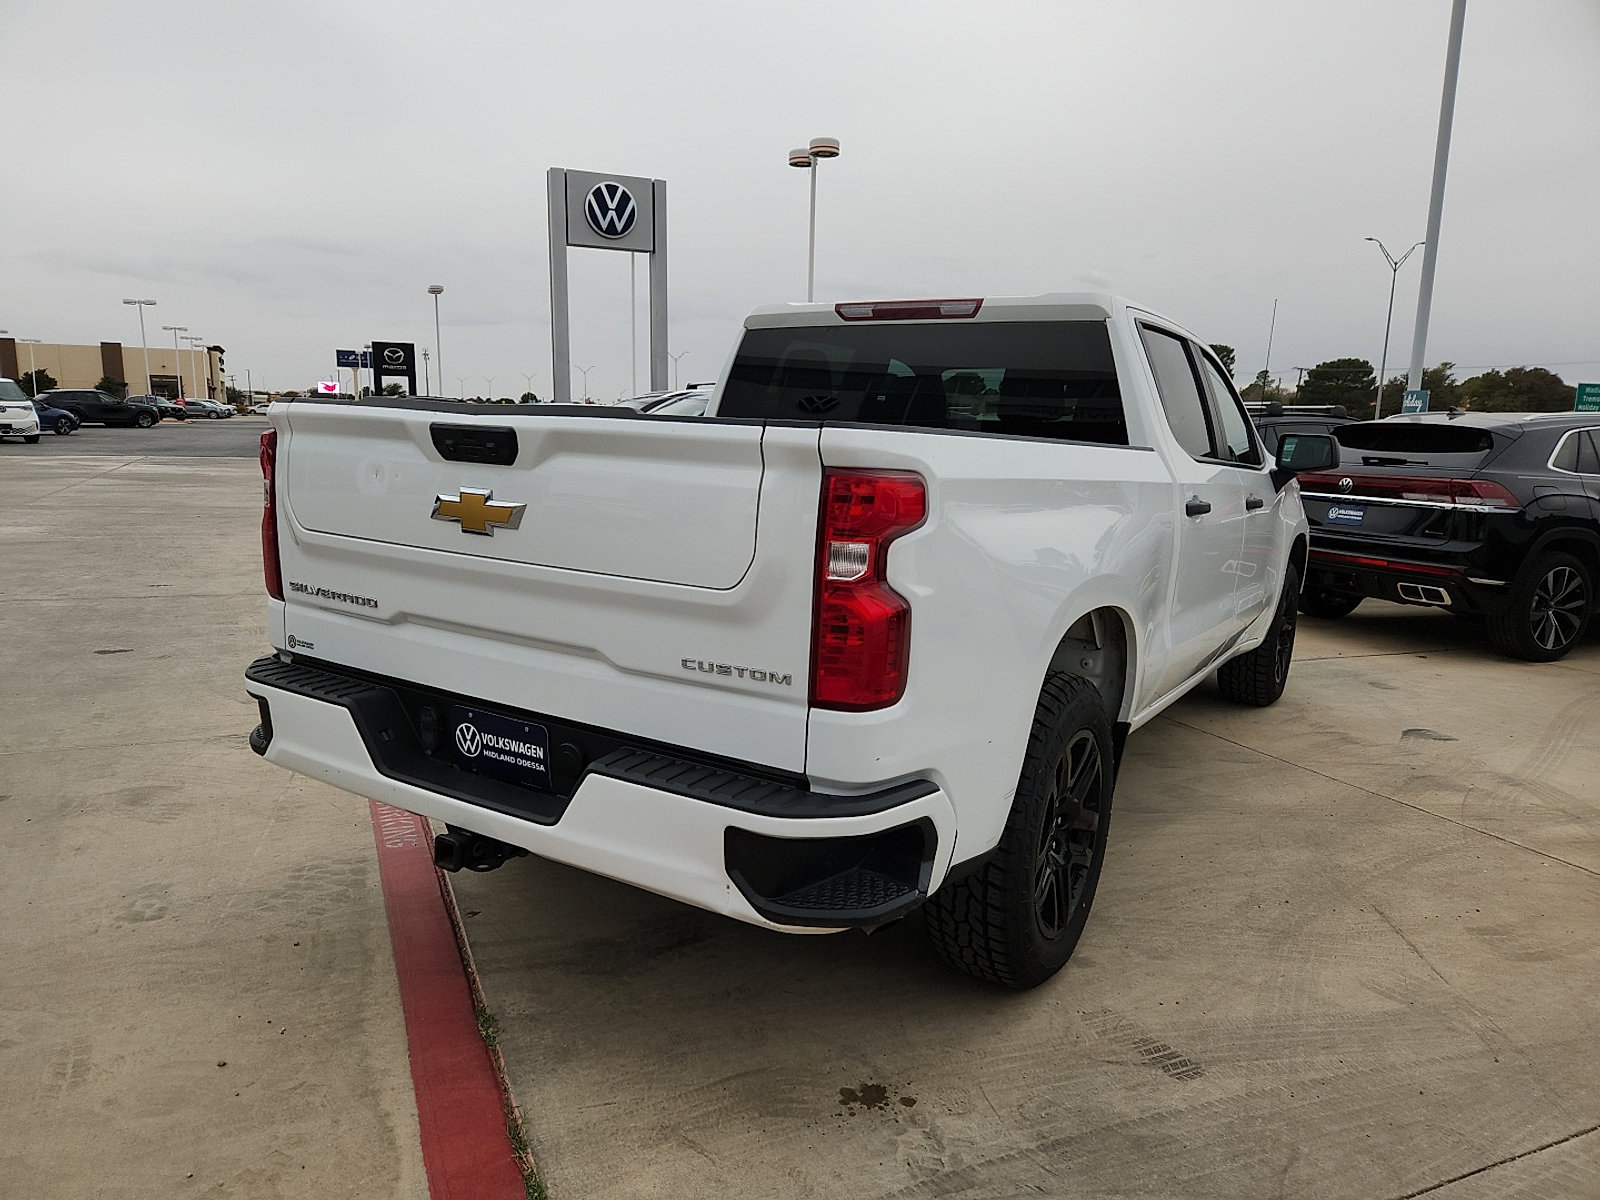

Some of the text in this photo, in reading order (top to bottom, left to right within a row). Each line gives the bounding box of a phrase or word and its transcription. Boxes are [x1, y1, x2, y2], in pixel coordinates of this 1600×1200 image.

[289, 581, 378, 608] SILVERADO
[681, 657, 792, 685] CUSTOM
[481, 732, 544, 760] VOLKSWAGEN
[483, 748, 546, 773] MIDLAND ODESSA
[376, 802, 418, 848] RKING
